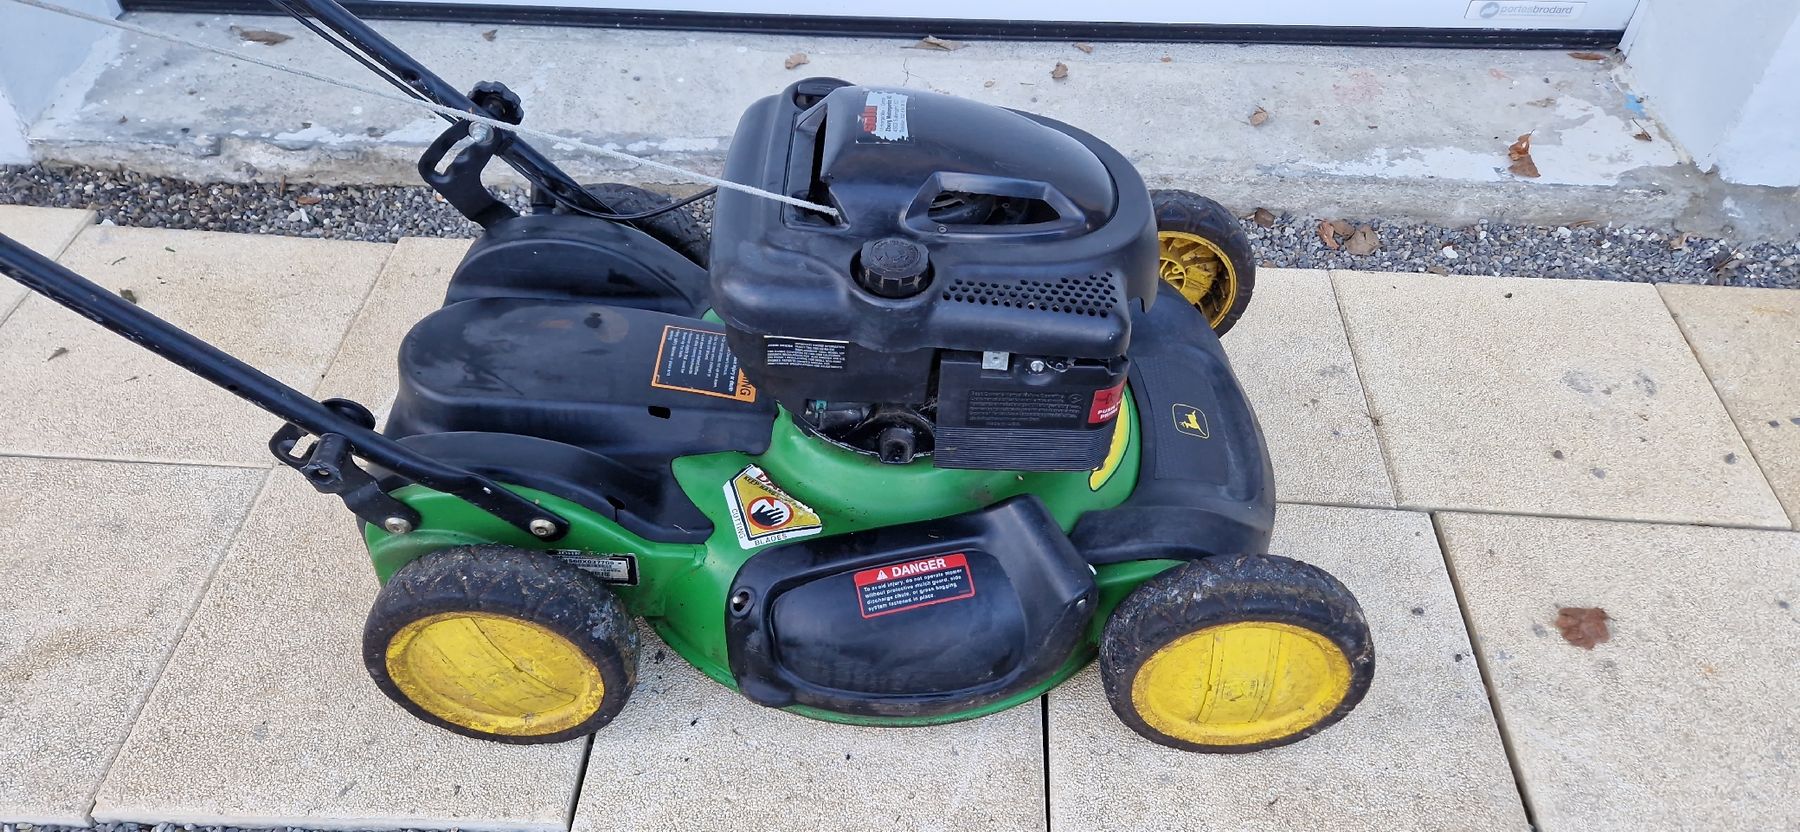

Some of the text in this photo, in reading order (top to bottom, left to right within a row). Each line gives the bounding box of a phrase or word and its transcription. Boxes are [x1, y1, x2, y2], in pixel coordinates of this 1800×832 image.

[744, 476, 759, 486] KEEP
[732, 509, 745, 539] CUTTING
[754, 534, 788, 546] BLADES
[892, 559, 946, 577] DANGER
[924, 573, 943, 581] operate
[865, 590, 886, 598] without
[887, 585, 913, 594] protective
[867, 597, 893, 605] discharge
[935, 583, 957, 591] bagging
[868, 604, 888, 612] system
